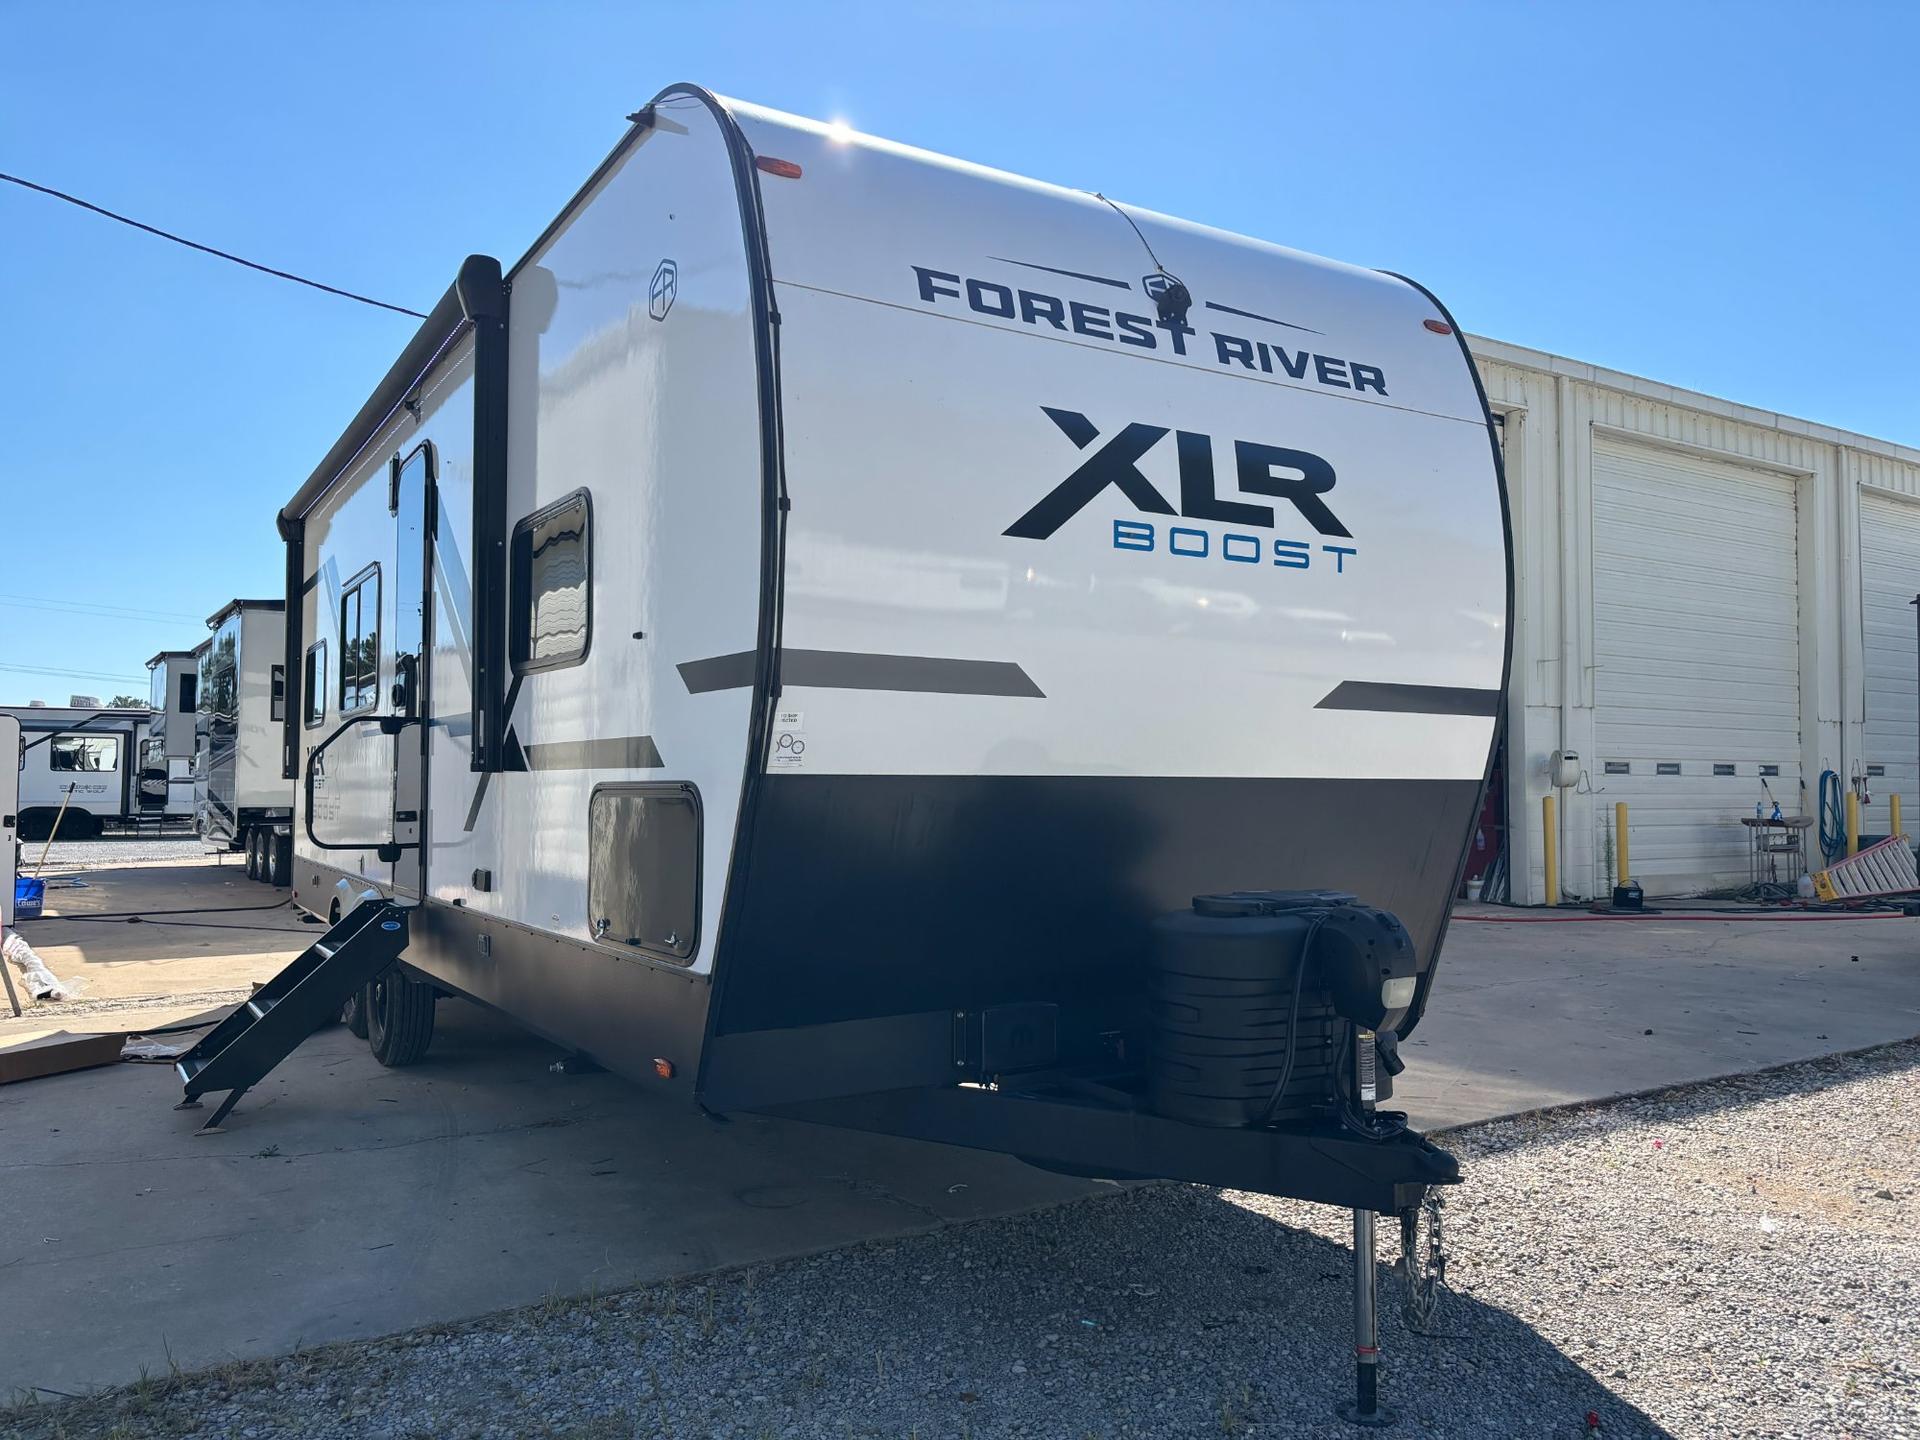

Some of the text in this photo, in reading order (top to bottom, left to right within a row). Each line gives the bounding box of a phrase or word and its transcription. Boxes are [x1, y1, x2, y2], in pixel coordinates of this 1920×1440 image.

[910, 265, 1196, 355] FOREST
[1210, 331, 1389, 396] RIVER
[1001, 405, 1354, 540] XLR
[1113, 519, 1358, 573] BOOST
